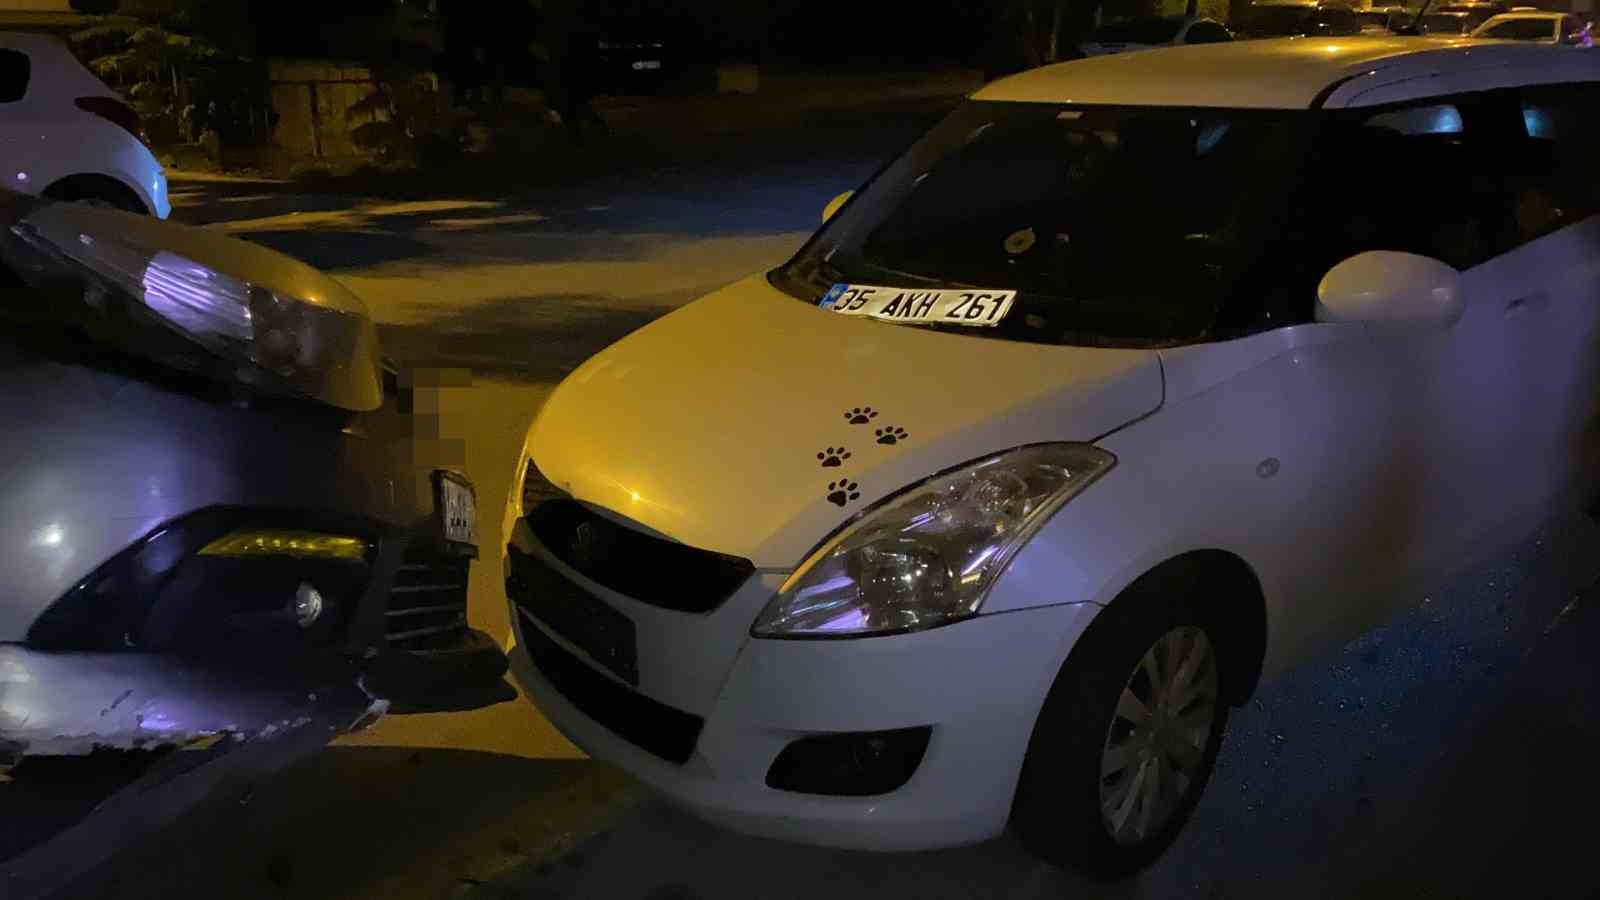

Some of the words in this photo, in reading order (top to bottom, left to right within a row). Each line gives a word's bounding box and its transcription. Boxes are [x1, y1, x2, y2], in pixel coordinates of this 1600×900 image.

[833, 288, 876, 310] 35
[879, 292, 941, 318] AKH
[945, 293, 1007, 320] 261
